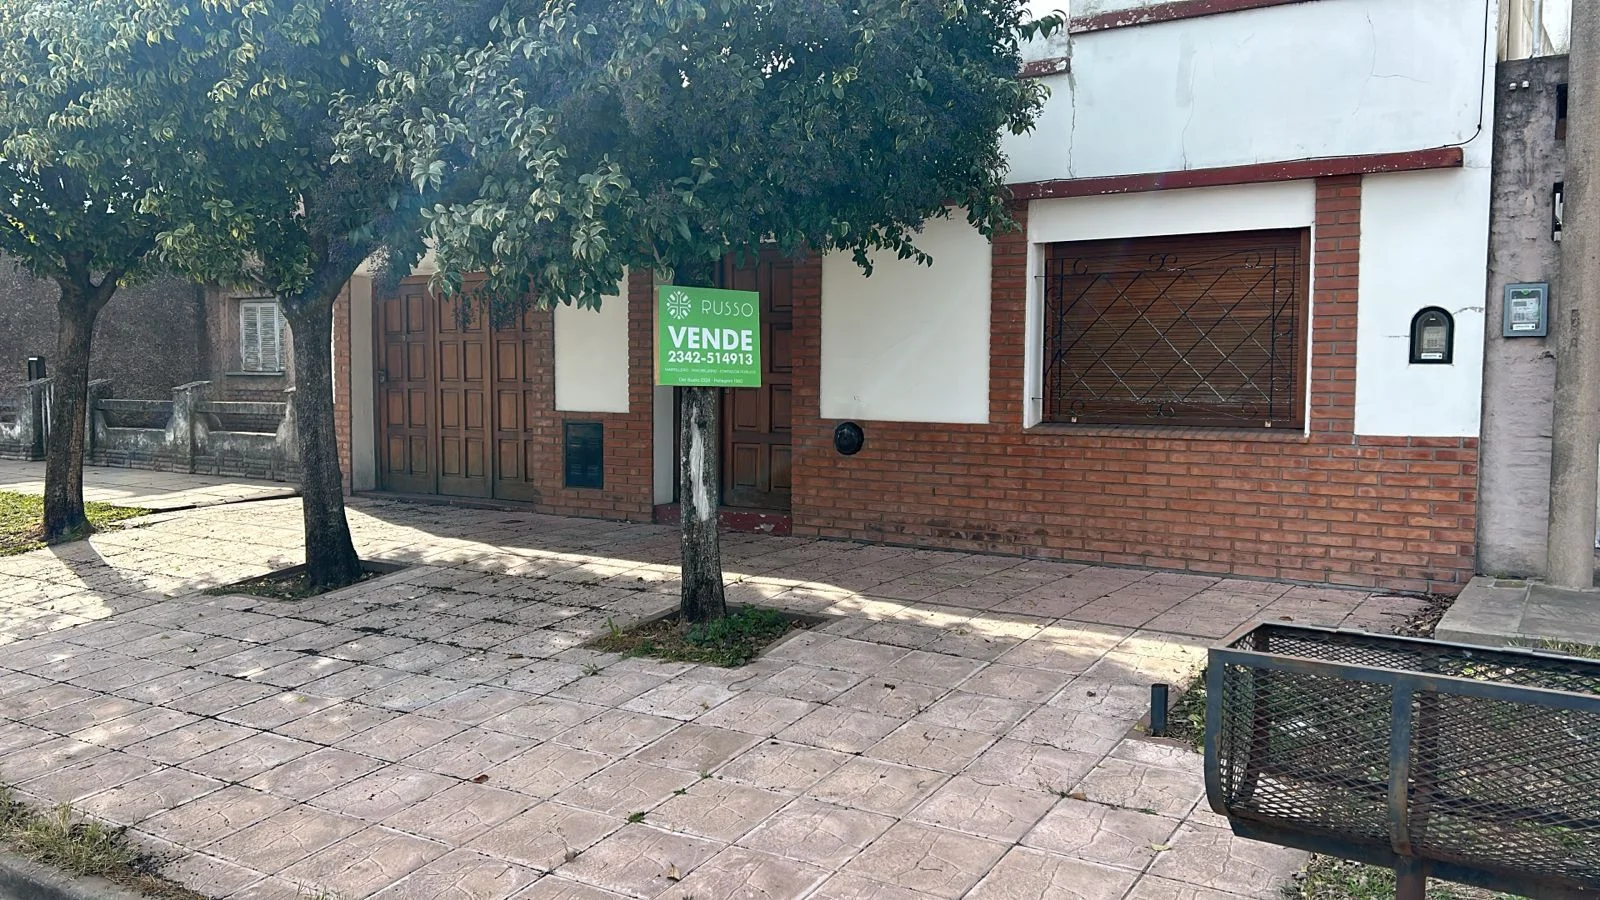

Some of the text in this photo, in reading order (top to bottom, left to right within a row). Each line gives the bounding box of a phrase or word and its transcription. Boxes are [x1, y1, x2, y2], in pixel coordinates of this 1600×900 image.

[701, 299, 754, 318] RUSSO
[667, 325, 753, 351] VENDE
[668, 350, 753, 365] 2342-514913
